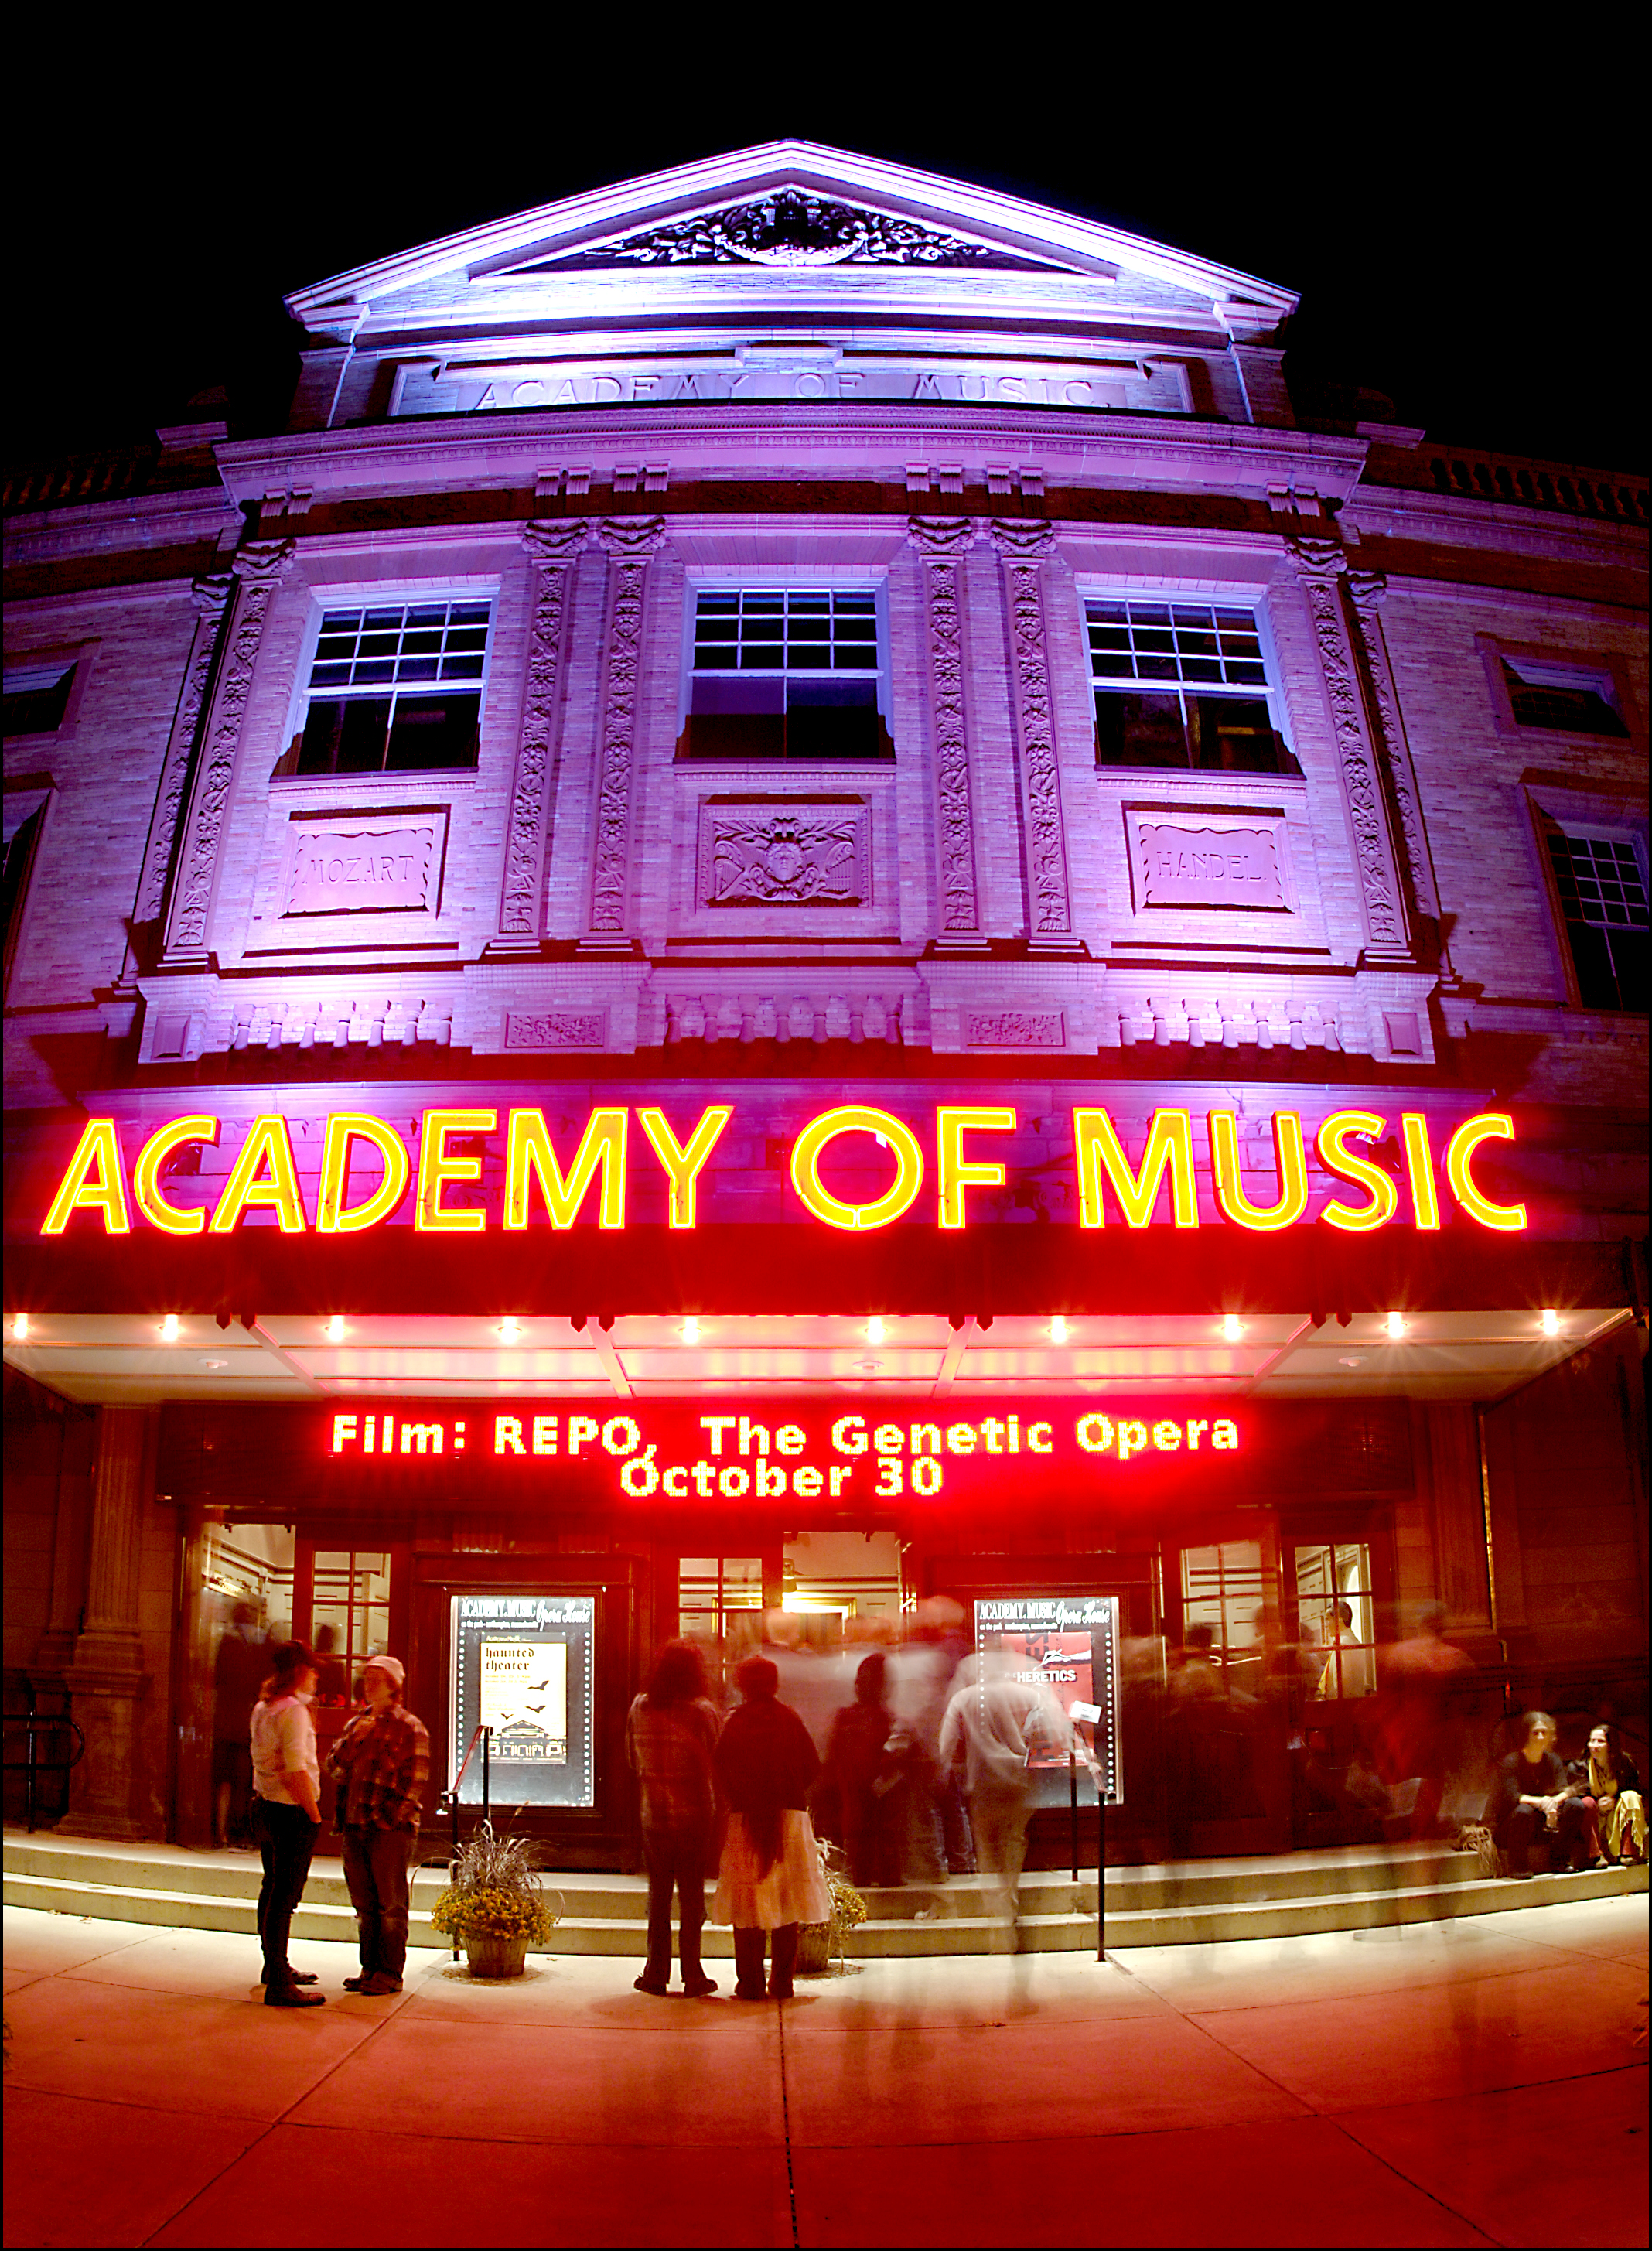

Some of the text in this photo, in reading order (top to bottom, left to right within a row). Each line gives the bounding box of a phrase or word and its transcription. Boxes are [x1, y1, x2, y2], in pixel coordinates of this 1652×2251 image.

[475, 373, 749, 410] ACADEMY
[794, 373, 865, 398] OF
[39, 1105, 1528, 1235] ACADEMY OF MUSIC
[331, 1414, 466, 1454] Film:
[699, 1416, 807, 1455] The
[831, 1415, 1053, 1456] Genetic
[1076, 1412, 1239, 1460] Opera
[620, 1457, 944, 1497] October 30
[1026, 1602, 1056, 1618] MUSIC
[486, 1647, 534, 1658] haunted
[486, 1659, 530, 1672] theater
[1017, 1669, 1077, 1682] HERETICS
